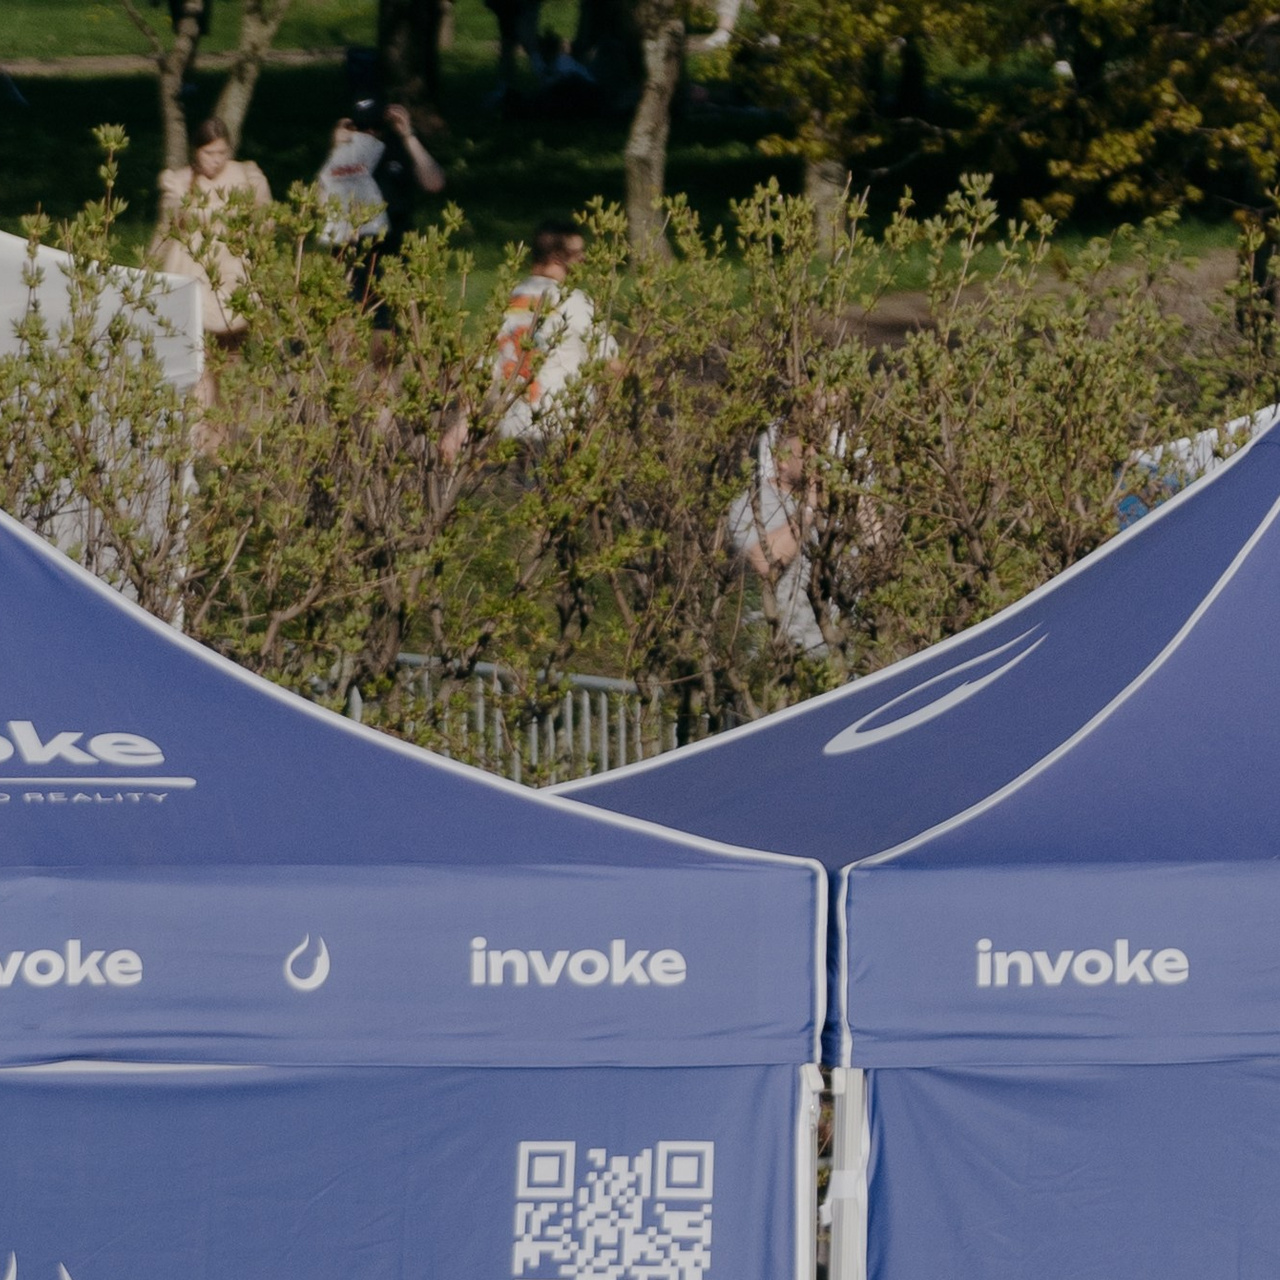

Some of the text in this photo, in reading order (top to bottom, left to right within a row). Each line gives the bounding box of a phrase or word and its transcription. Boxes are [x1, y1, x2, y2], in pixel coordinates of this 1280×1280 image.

[22, 791, 168, 803] REALITY
[470, 936, 687, 987] invoke
[977, 938, 1189, 987] invoke
